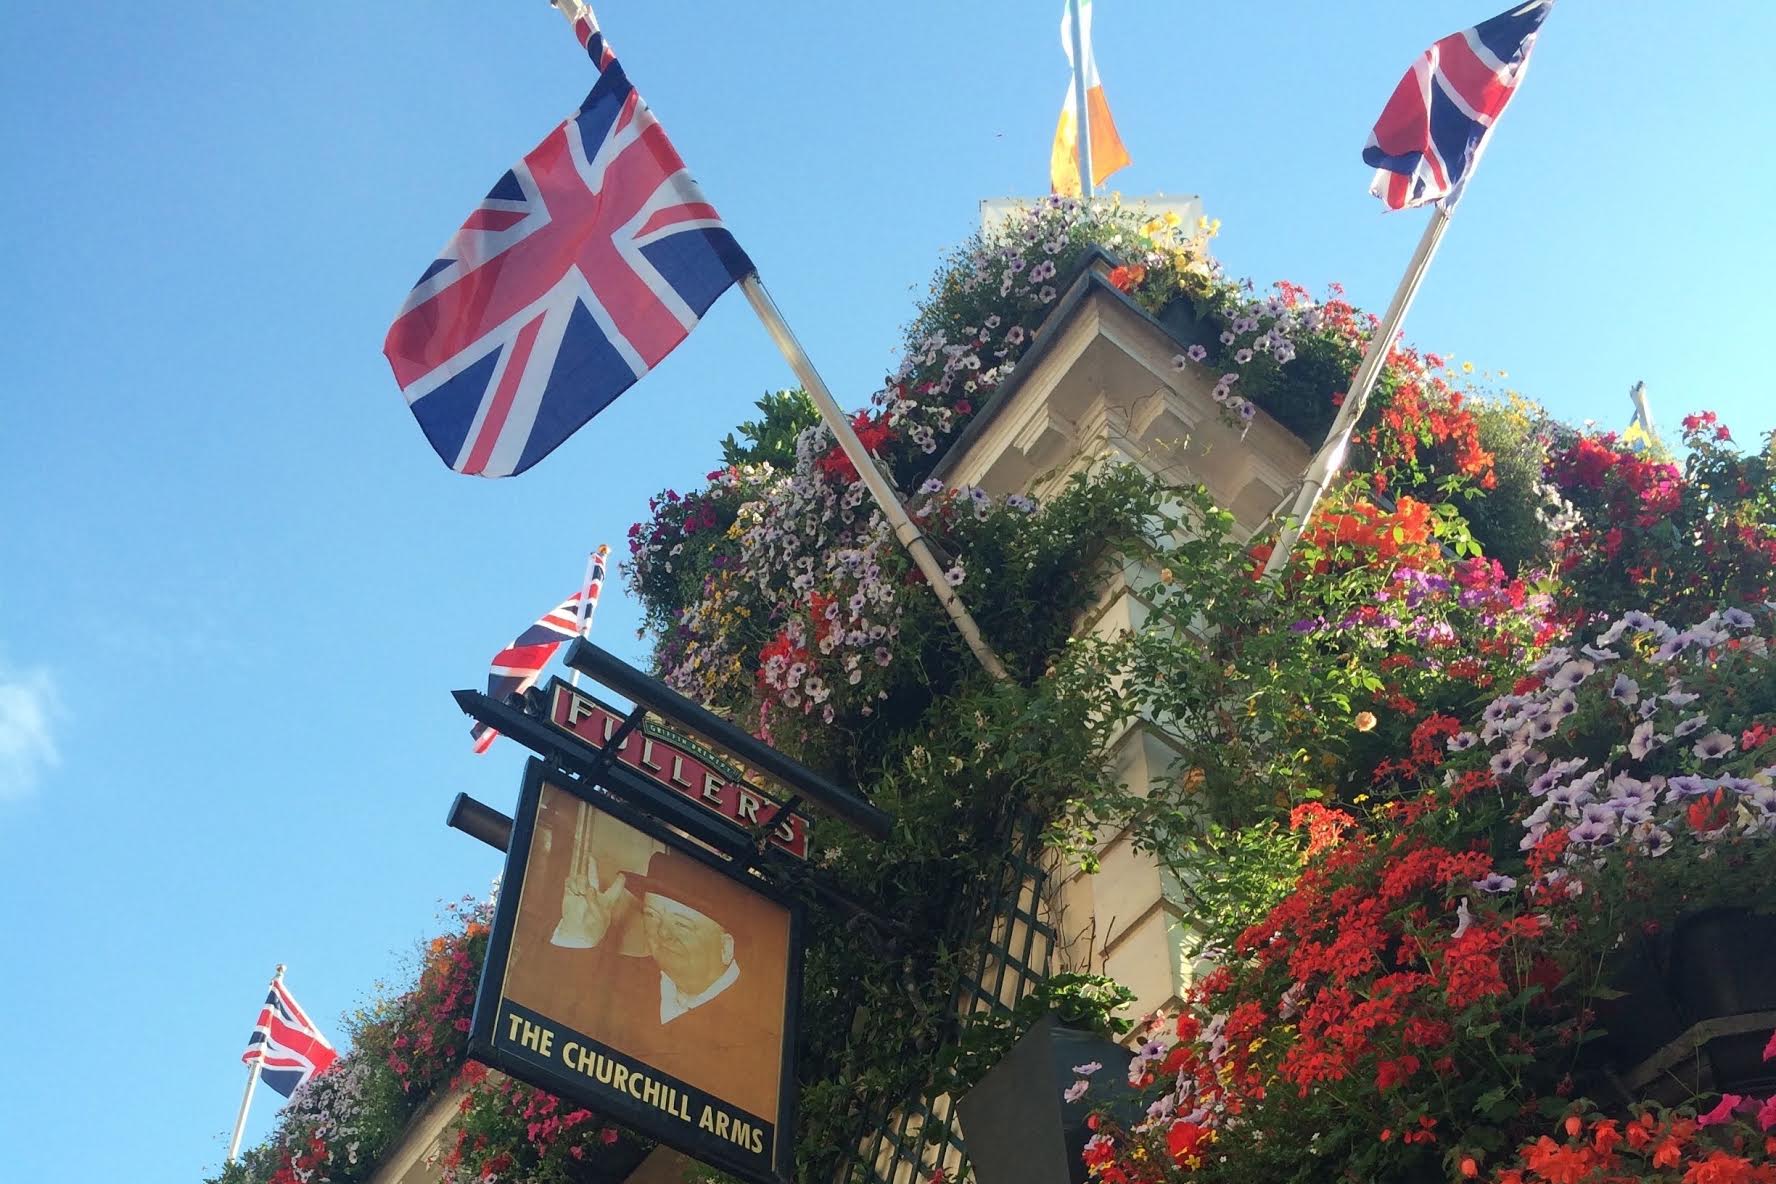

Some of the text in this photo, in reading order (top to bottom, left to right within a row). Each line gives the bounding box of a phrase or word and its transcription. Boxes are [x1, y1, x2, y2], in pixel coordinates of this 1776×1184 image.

[508, 1013, 764, 1154] THE CHURCHILL ARMS
